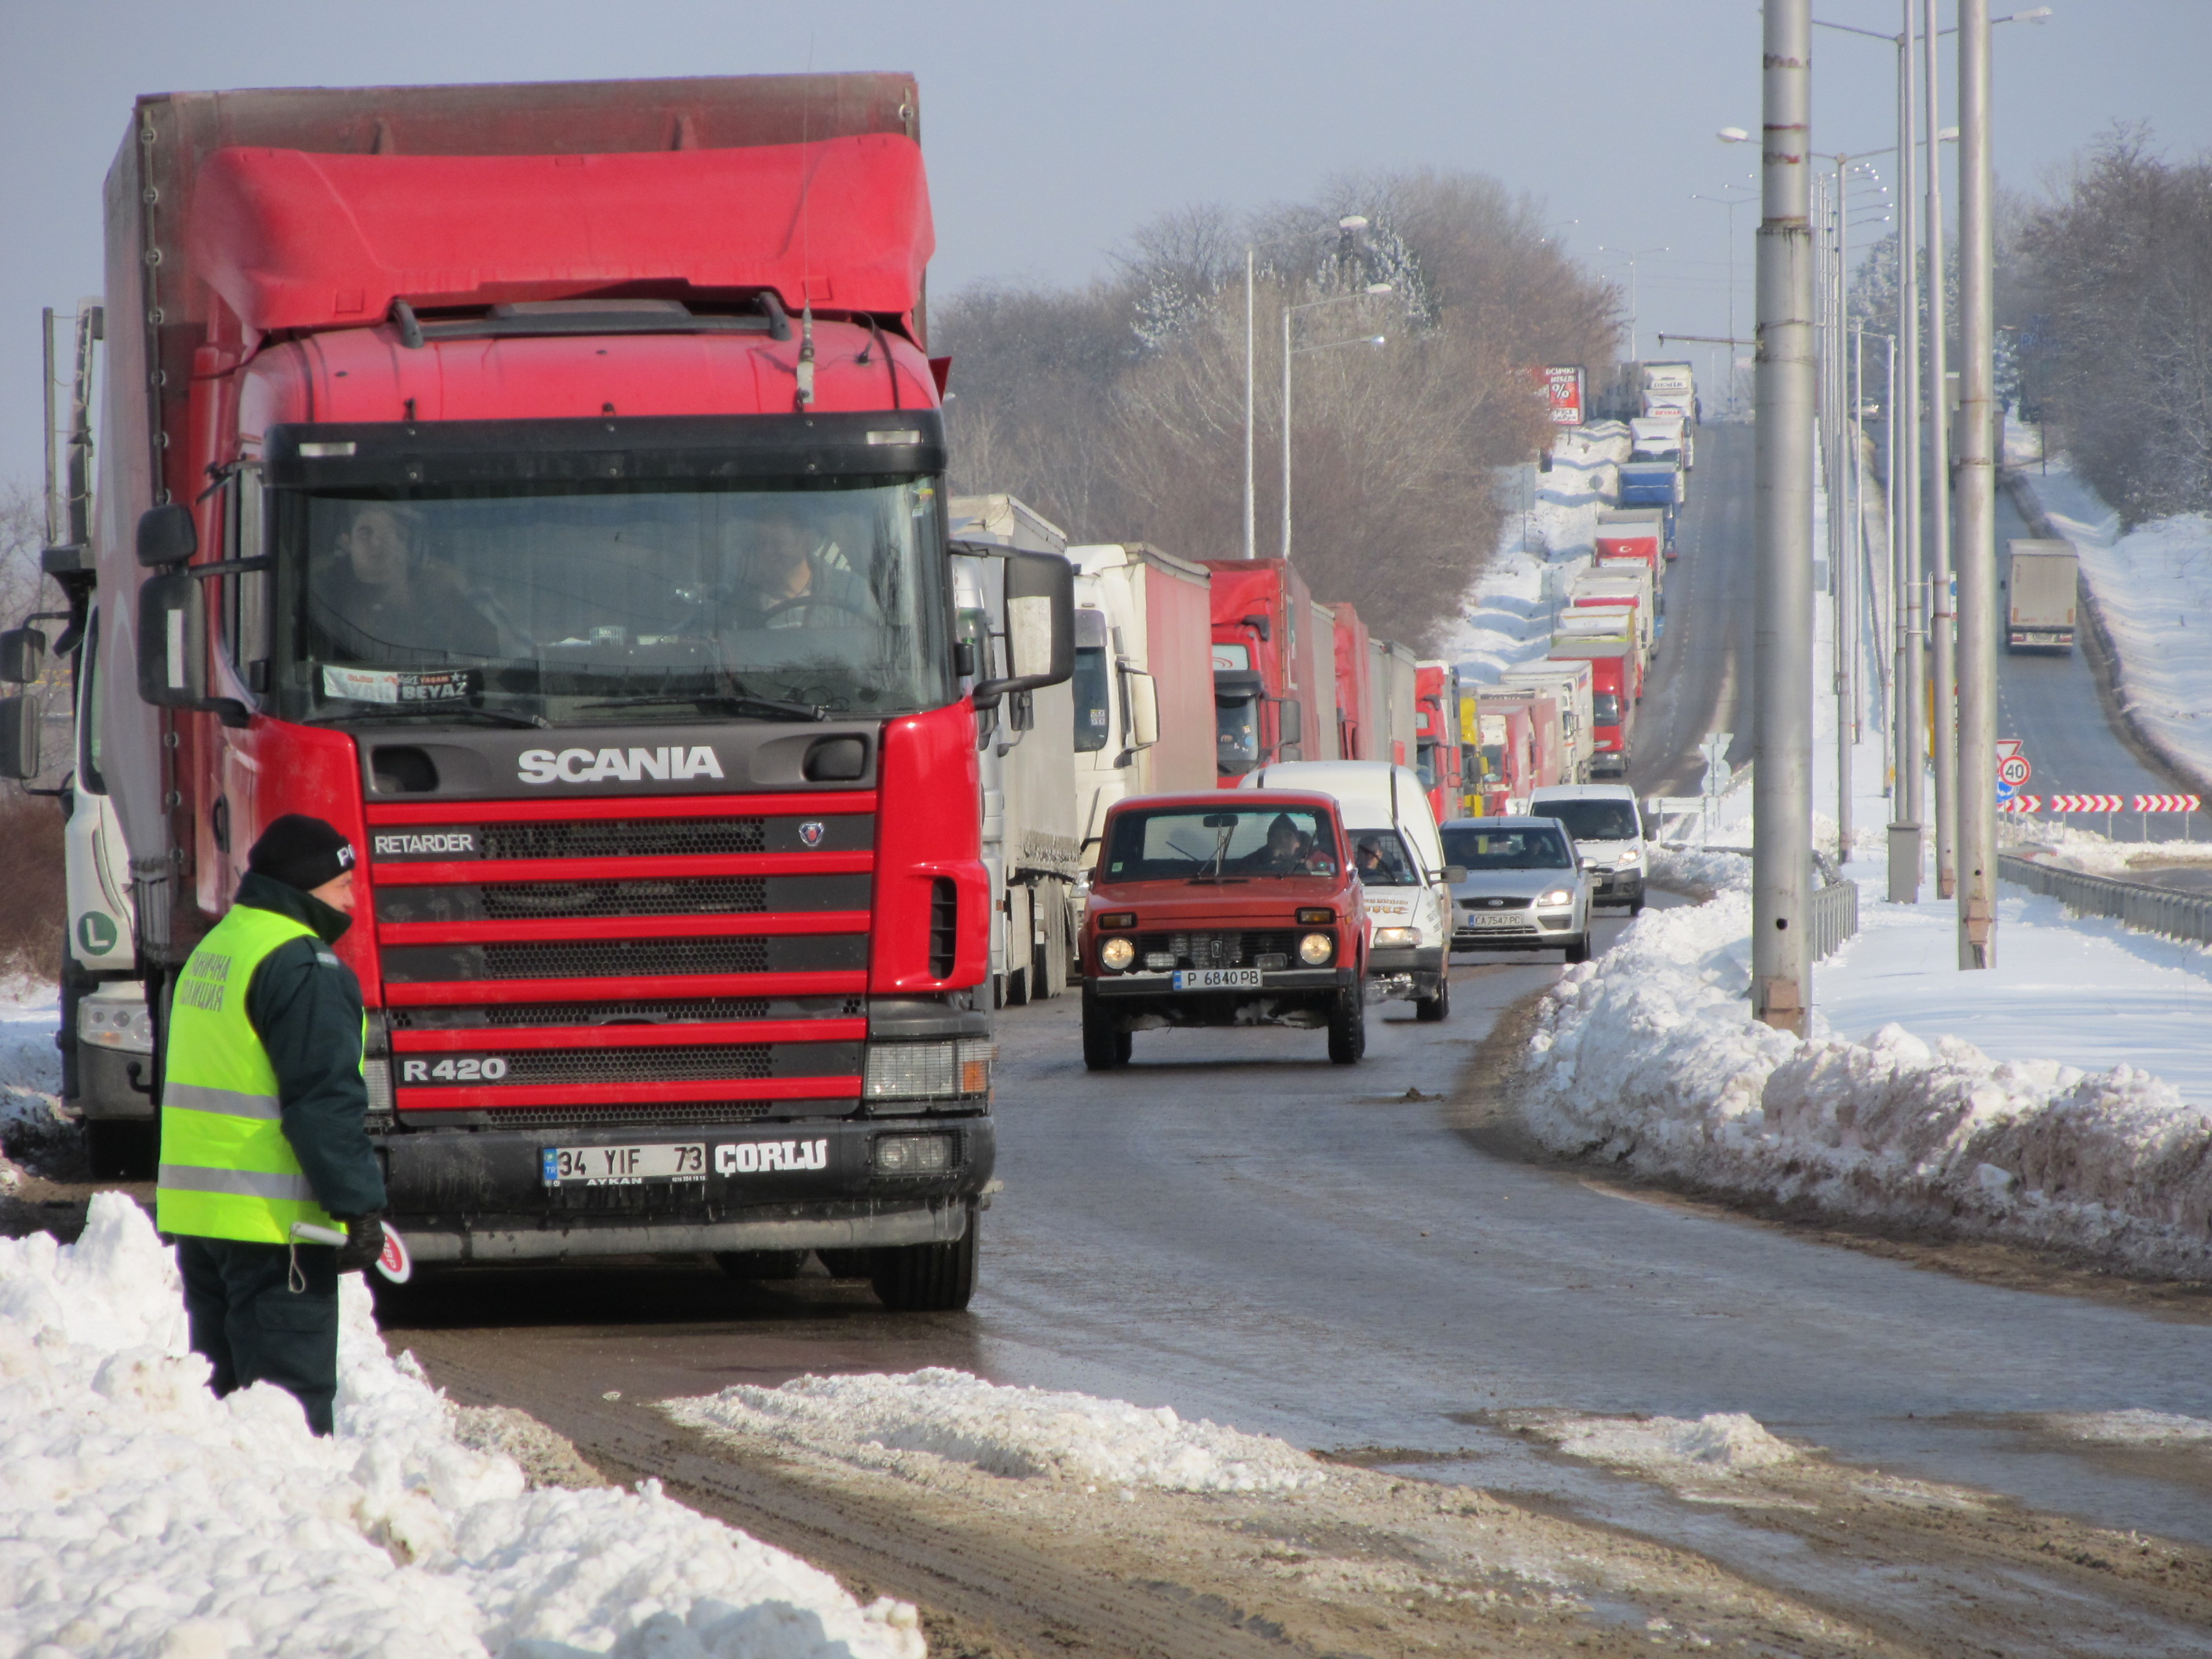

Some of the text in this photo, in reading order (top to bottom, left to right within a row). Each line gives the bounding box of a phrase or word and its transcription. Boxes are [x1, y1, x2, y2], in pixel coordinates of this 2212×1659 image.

[402, 682, 467, 700] BEYAZ
[518, 746, 724, 784] SCANIA
[2005, 764, 2024, 778] 40
[374, 833, 474, 854] RETARDER
[1488, 916, 1507, 925] 7547
[86, 918, 108, 947] L
[1188, 971, 1258, 986] P 6840 PB
[404, 1058, 506, 1082] R 420
[558, 1147, 702, 1176] 34 YIF 73
[715, 1139, 827, 1177] ÇORLU
[546, 1166, 556, 1174] TR
[586, 1177, 642, 1186] AYKAN
